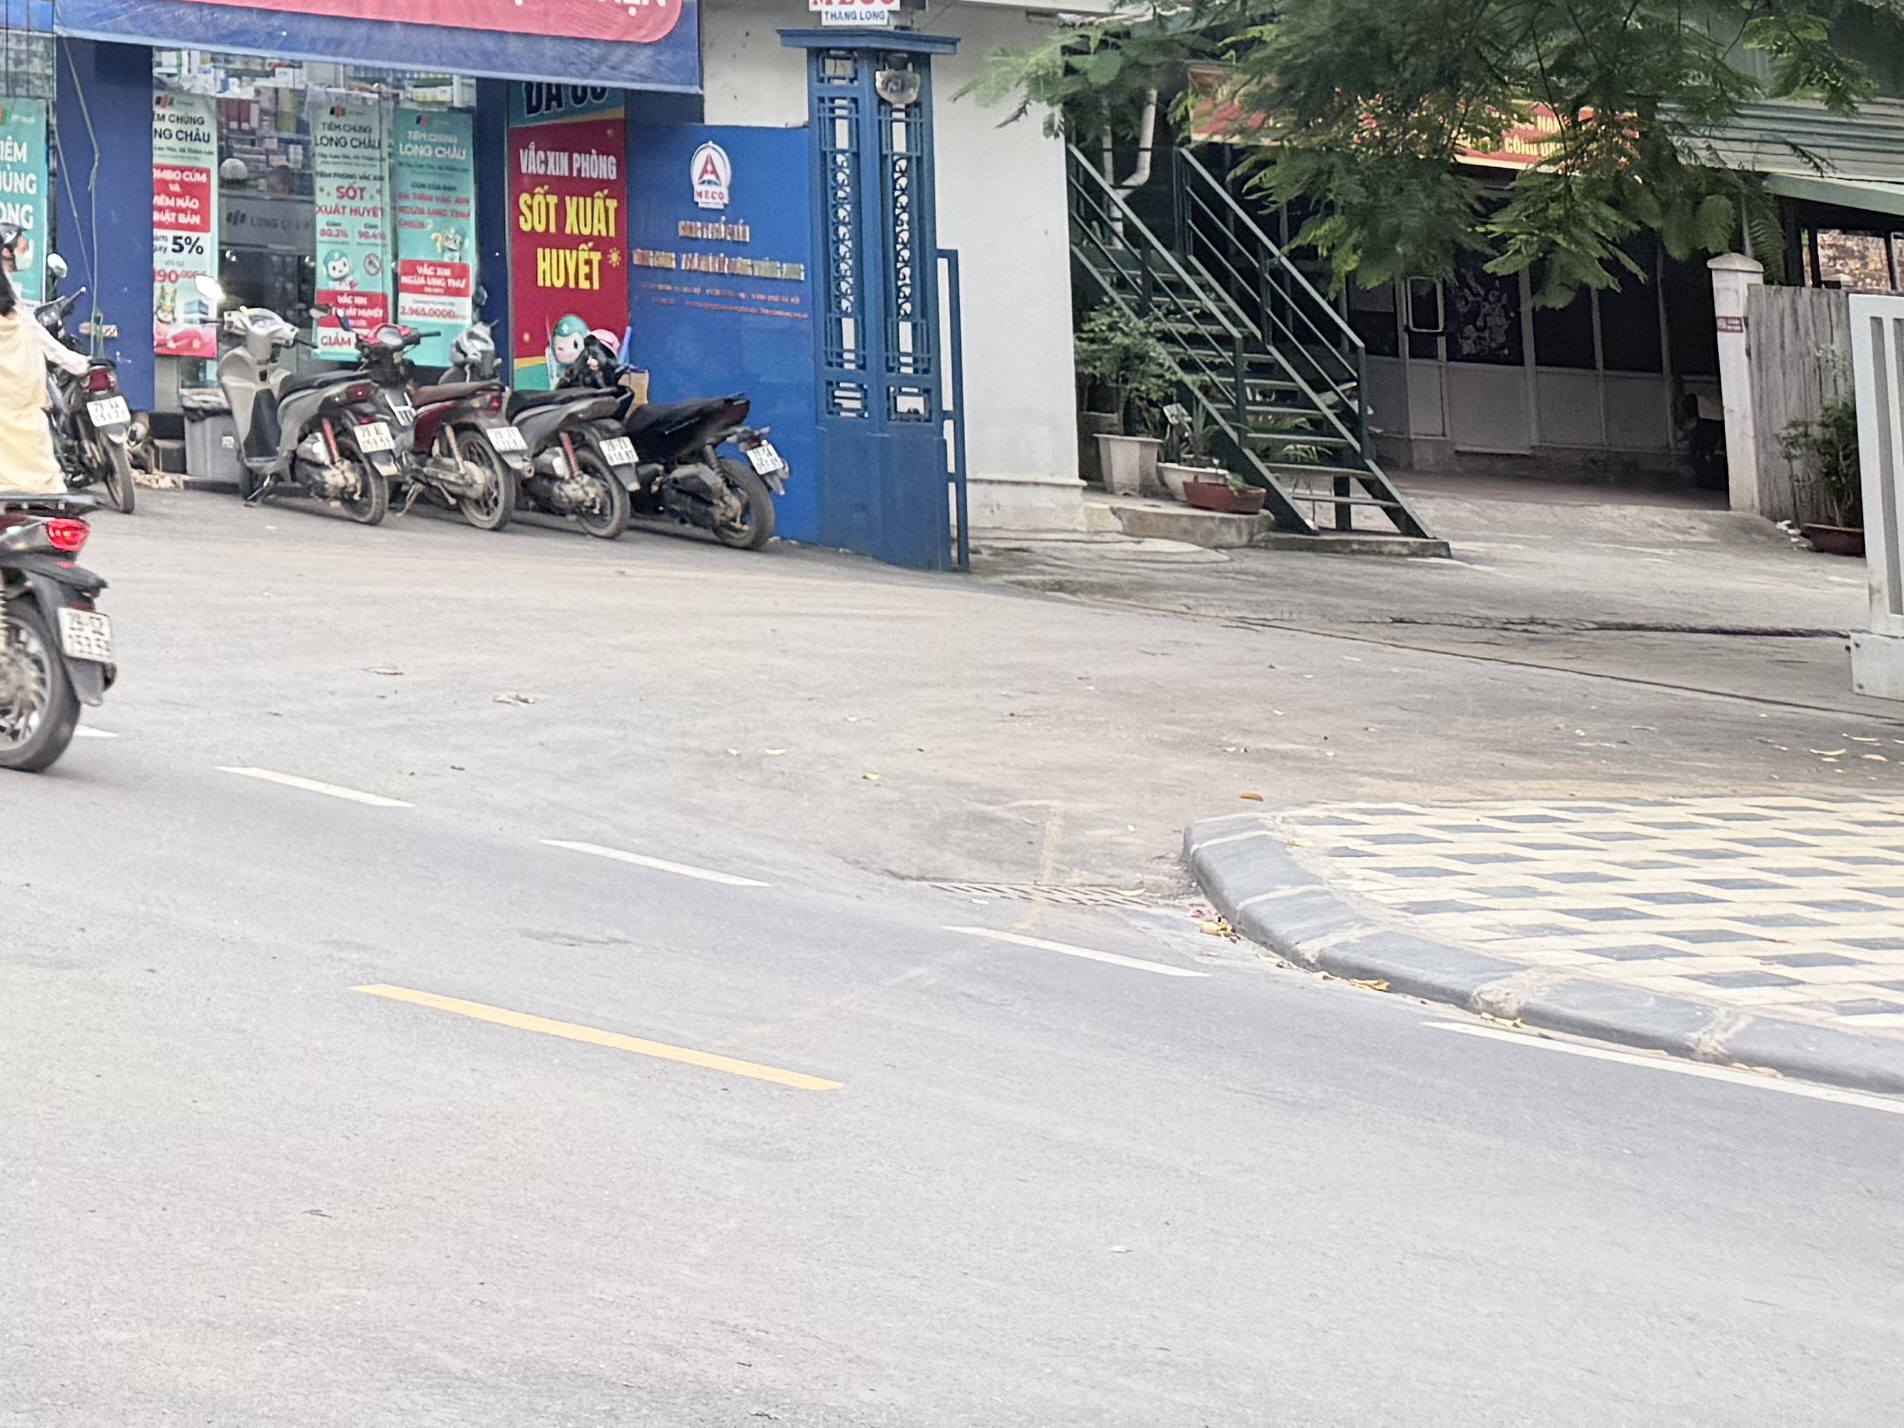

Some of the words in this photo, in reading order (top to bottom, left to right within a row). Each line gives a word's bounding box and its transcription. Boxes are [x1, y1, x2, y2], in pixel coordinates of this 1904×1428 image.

[860, 11, 885, 21] LONG
[176, 128, 210, 143] CHÂU
[520, 141, 546, 175] VẮC
[547, 151, 569, 177] XIN
[573, 148, 617, 180] PHÒNG
[696, 189, 725, 201] MECO
[519, 185, 558, 234] SỐT
[565, 189, 618, 238] XUẤT
[171, 235, 204, 255] 5%
[537, 241, 602, 290] HUYẾT
